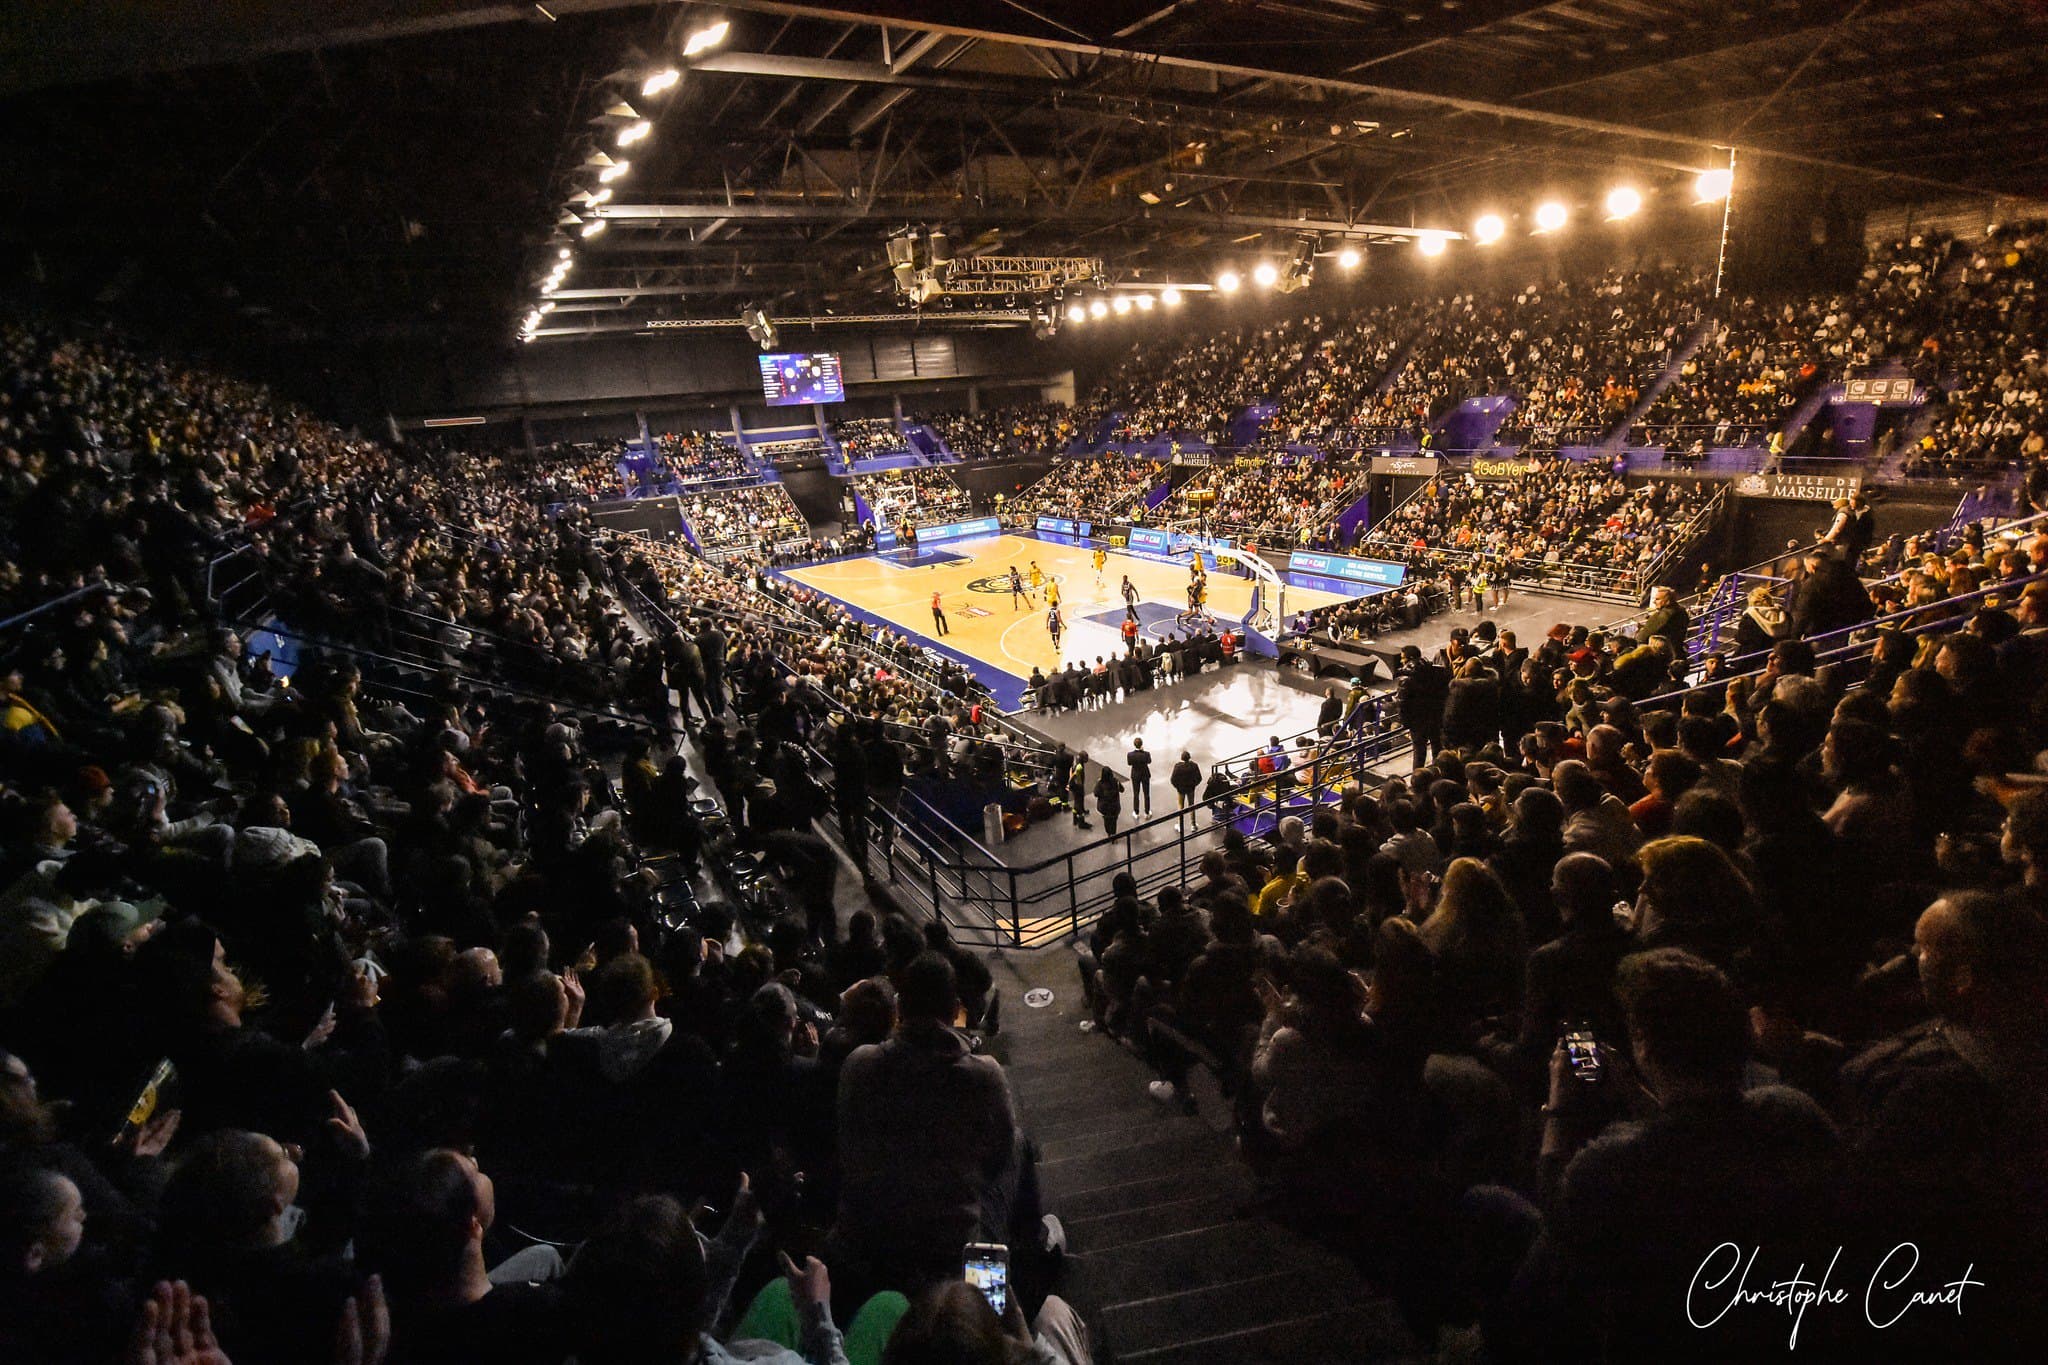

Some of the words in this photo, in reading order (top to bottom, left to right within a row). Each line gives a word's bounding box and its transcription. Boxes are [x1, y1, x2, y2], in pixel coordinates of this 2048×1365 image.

[1776, 476, 1824, 486] VILLE
[1836, 478, 1857, 487] DE
[1772, 486, 1857, 500] MARSEILLE
